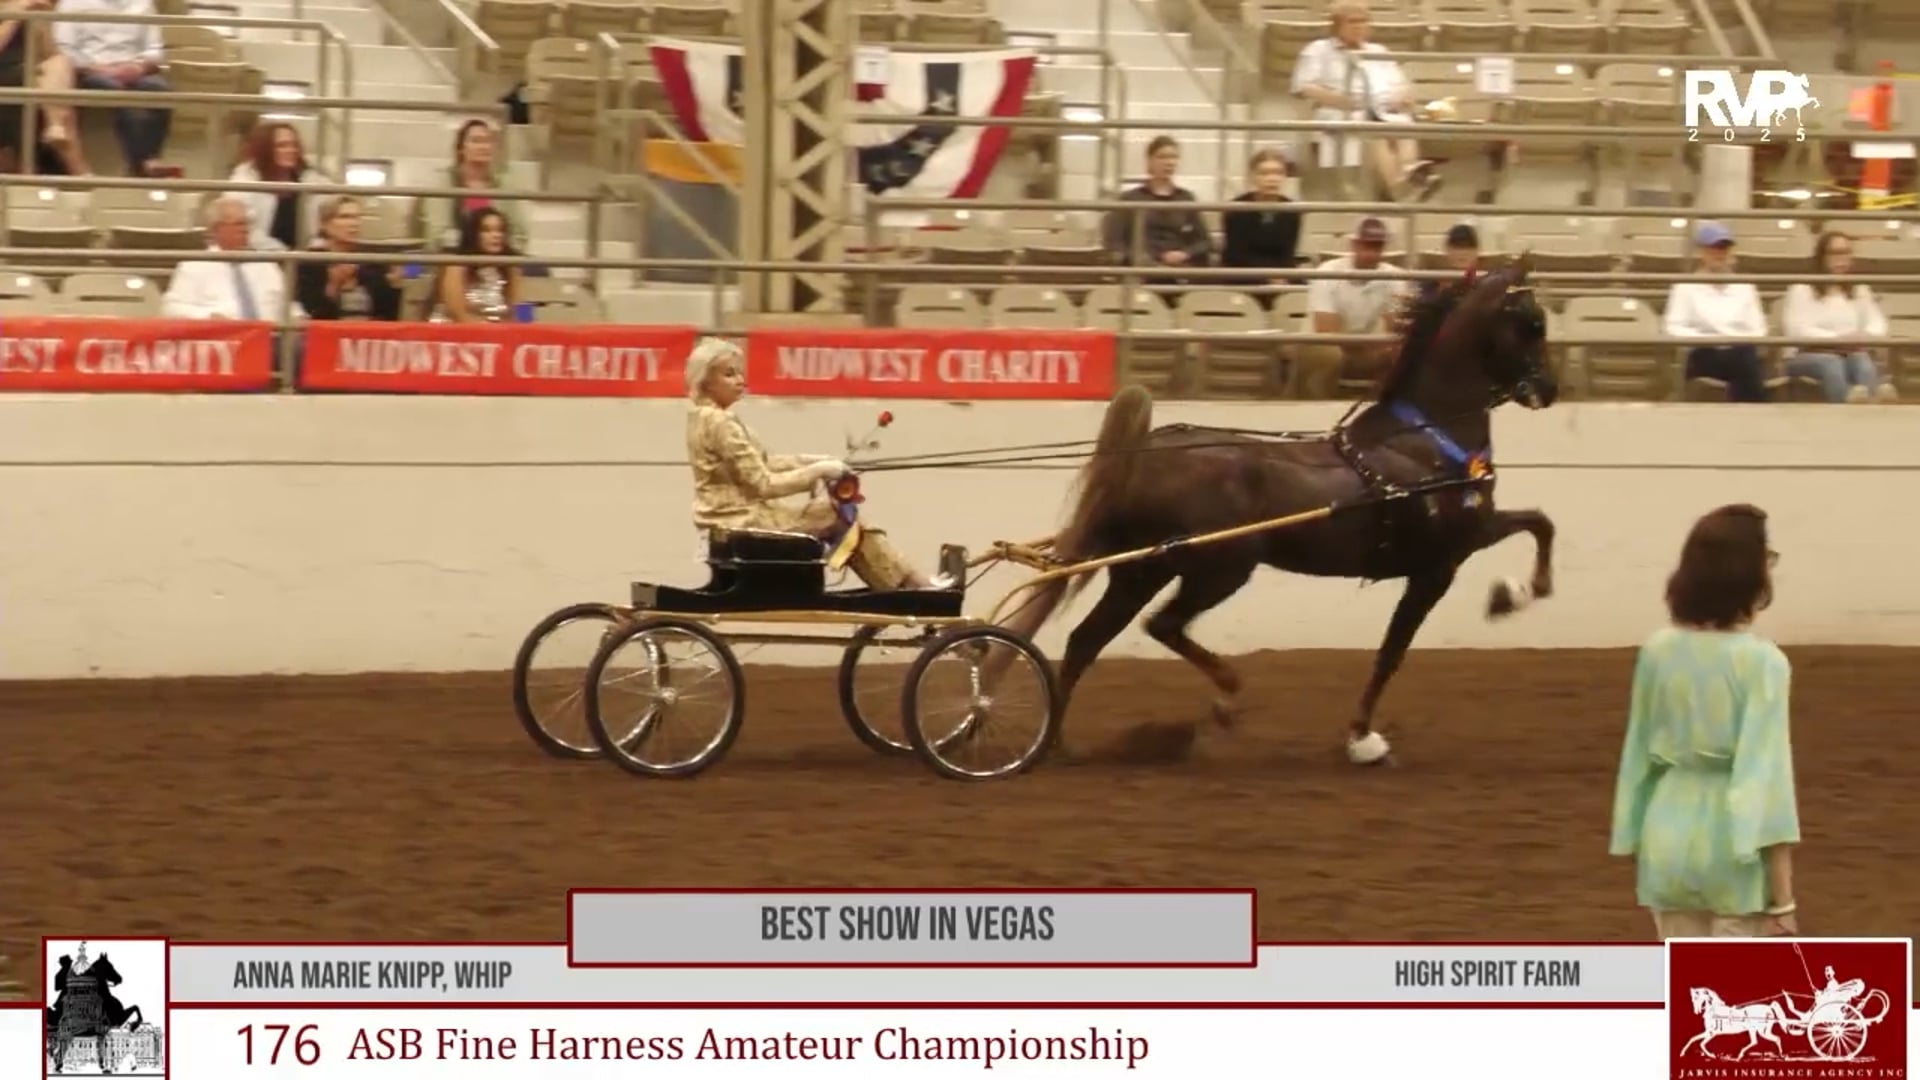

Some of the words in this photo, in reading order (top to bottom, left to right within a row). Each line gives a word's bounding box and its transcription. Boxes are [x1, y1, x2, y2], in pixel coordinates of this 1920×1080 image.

[75, 338, 243, 376] CHARITY
[334, 337, 504, 377] MIDWEST
[512, 344, 667, 381] CHARITY
[774, 346, 929, 383] MIDWEST
[937, 349, 1087, 384] CHARITY
